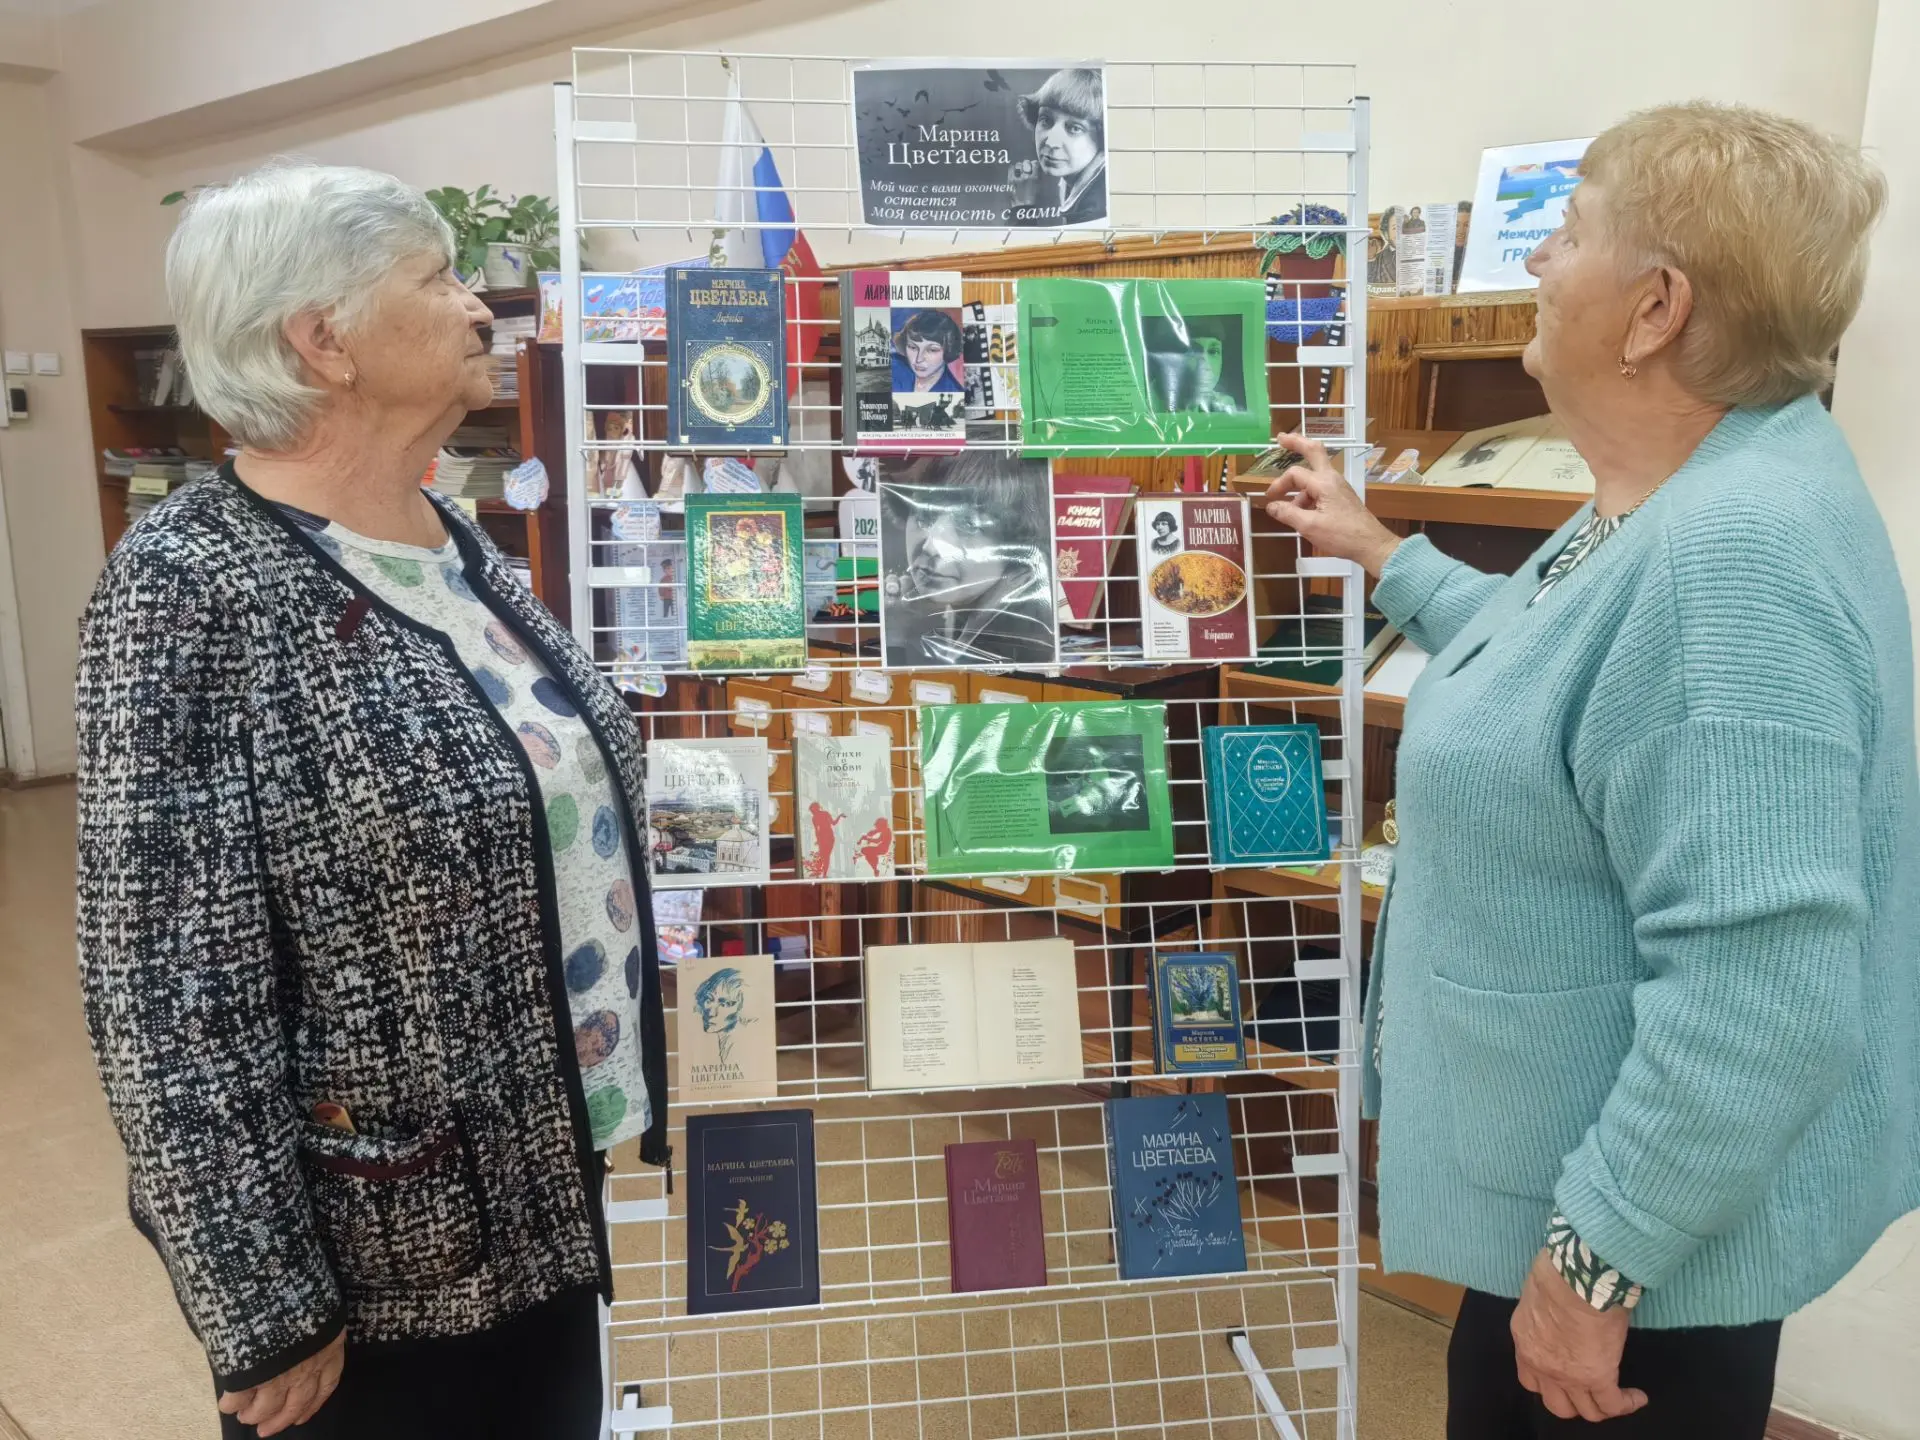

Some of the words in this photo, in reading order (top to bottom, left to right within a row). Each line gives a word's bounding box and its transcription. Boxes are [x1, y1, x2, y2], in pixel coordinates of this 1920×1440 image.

[918, 124, 1001, 148] Марина
[887, 142, 1011, 169] Цветаева
[869, 180, 896, 193] Мой
[898, 184, 919, 194] час
[921, 185, 929, 194] с
[931, 183, 962, 194] вами
[964, 183, 1017, 195] окончен,
[884, 195, 957, 207] остается
[871, 207, 905, 221] моя
[909, 207, 996, 222] вечность
[1001, 208, 1012, 221] с
[1015, 205, 1062, 220] вами
[1497, 228, 1557, 241] Междун
[711, 279, 746, 289] МАРИНА
[689, 289, 769, 309] ЦВЕТАЕВА
[864, 284, 903, 301] МАРИНА
[907, 284, 951, 301] ЦВЕТАЕВА
[1067, 505, 1101, 517] КНИГА
[1193, 508, 1232, 524] МАРИНА
[854, 518, 878, 536] 202
[1057, 516, 1101, 529] ПАМЯТИ
[1189, 527, 1239, 547] ЦВЕТАЕВА
[691, 1063, 740, 1073] МАРИНА
[691, 1072, 745, 1083] ЦВЕТАЕВА
[1142, 1131, 1203, 1149] МАРИНА
[707, 1160, 746, 1171] МАРИНА
[749, 1157, 795, 1169] ЦВЕТАЕВА
[1132, 1147, 1217, 1171] ЦВЕТАЕВА
